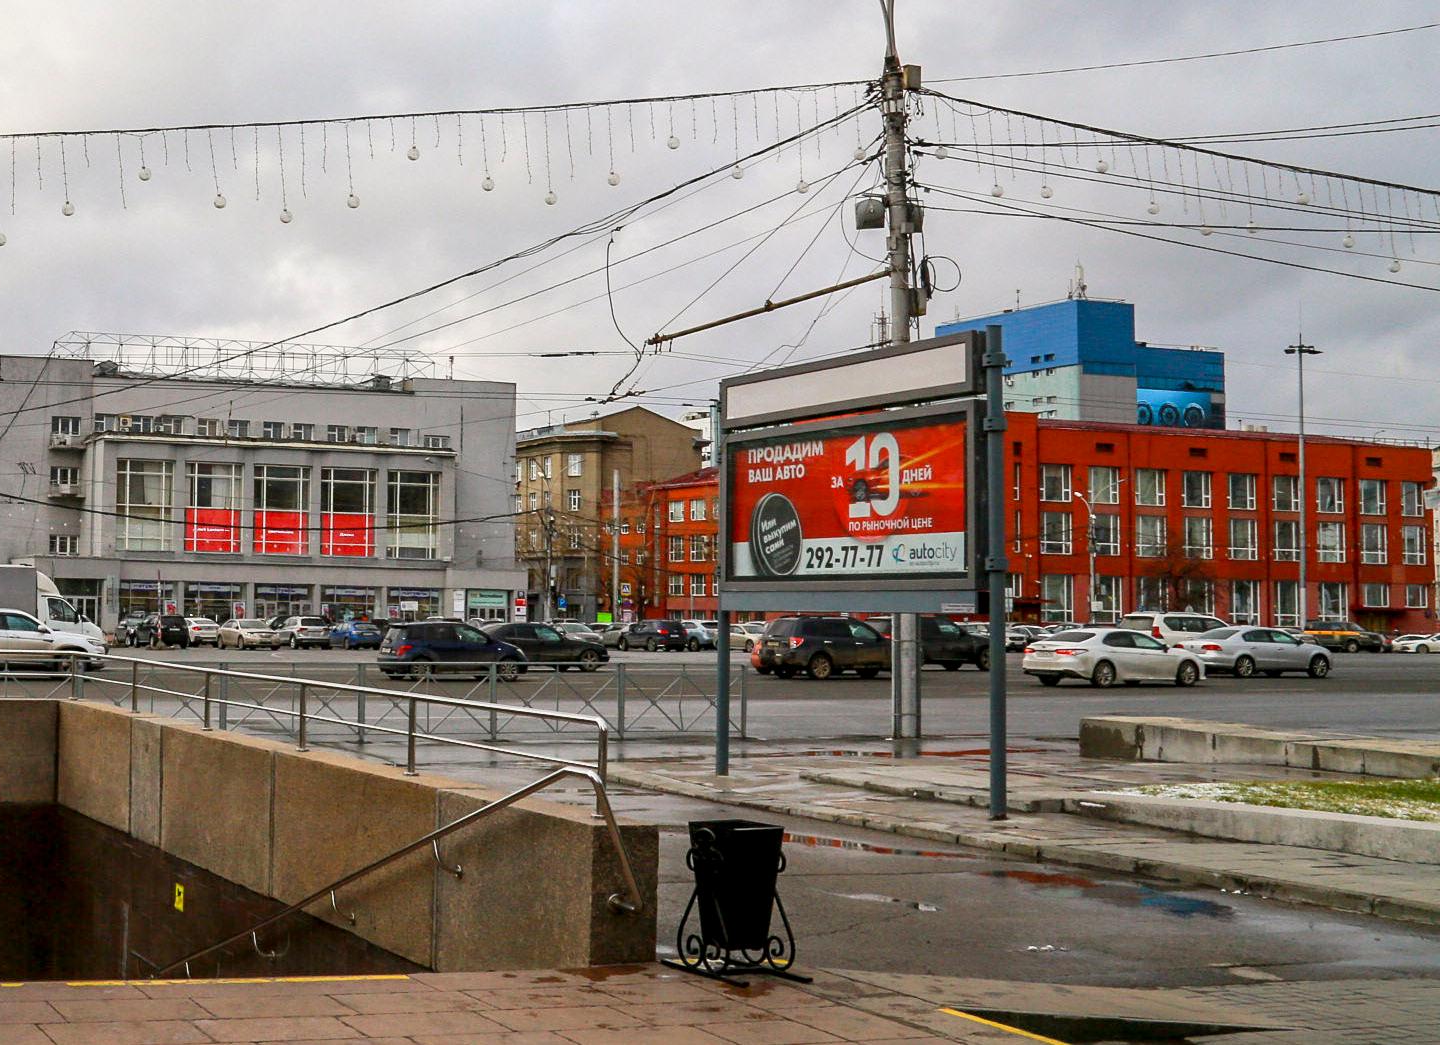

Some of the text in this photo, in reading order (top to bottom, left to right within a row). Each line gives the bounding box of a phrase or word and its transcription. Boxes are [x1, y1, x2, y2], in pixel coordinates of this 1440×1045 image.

[747, 440, 824, 464] ПРОДАДИМ
[748, 464, 805, 483] ВАШ АВТО
[831, 432, 932, 519] ЗА 10 ДНЕЙ
[761, 518, 777, 532] Или
[763, 519, 797, 544] выкупим
[848, 517, 933, 532] ПО РЫНОЧНОЙ ЦЕНЕ
[765, 538, 785, 554] сами
[909, 541, 958, 561] autocity
[805, 544, 885, 569] 292-77-77
